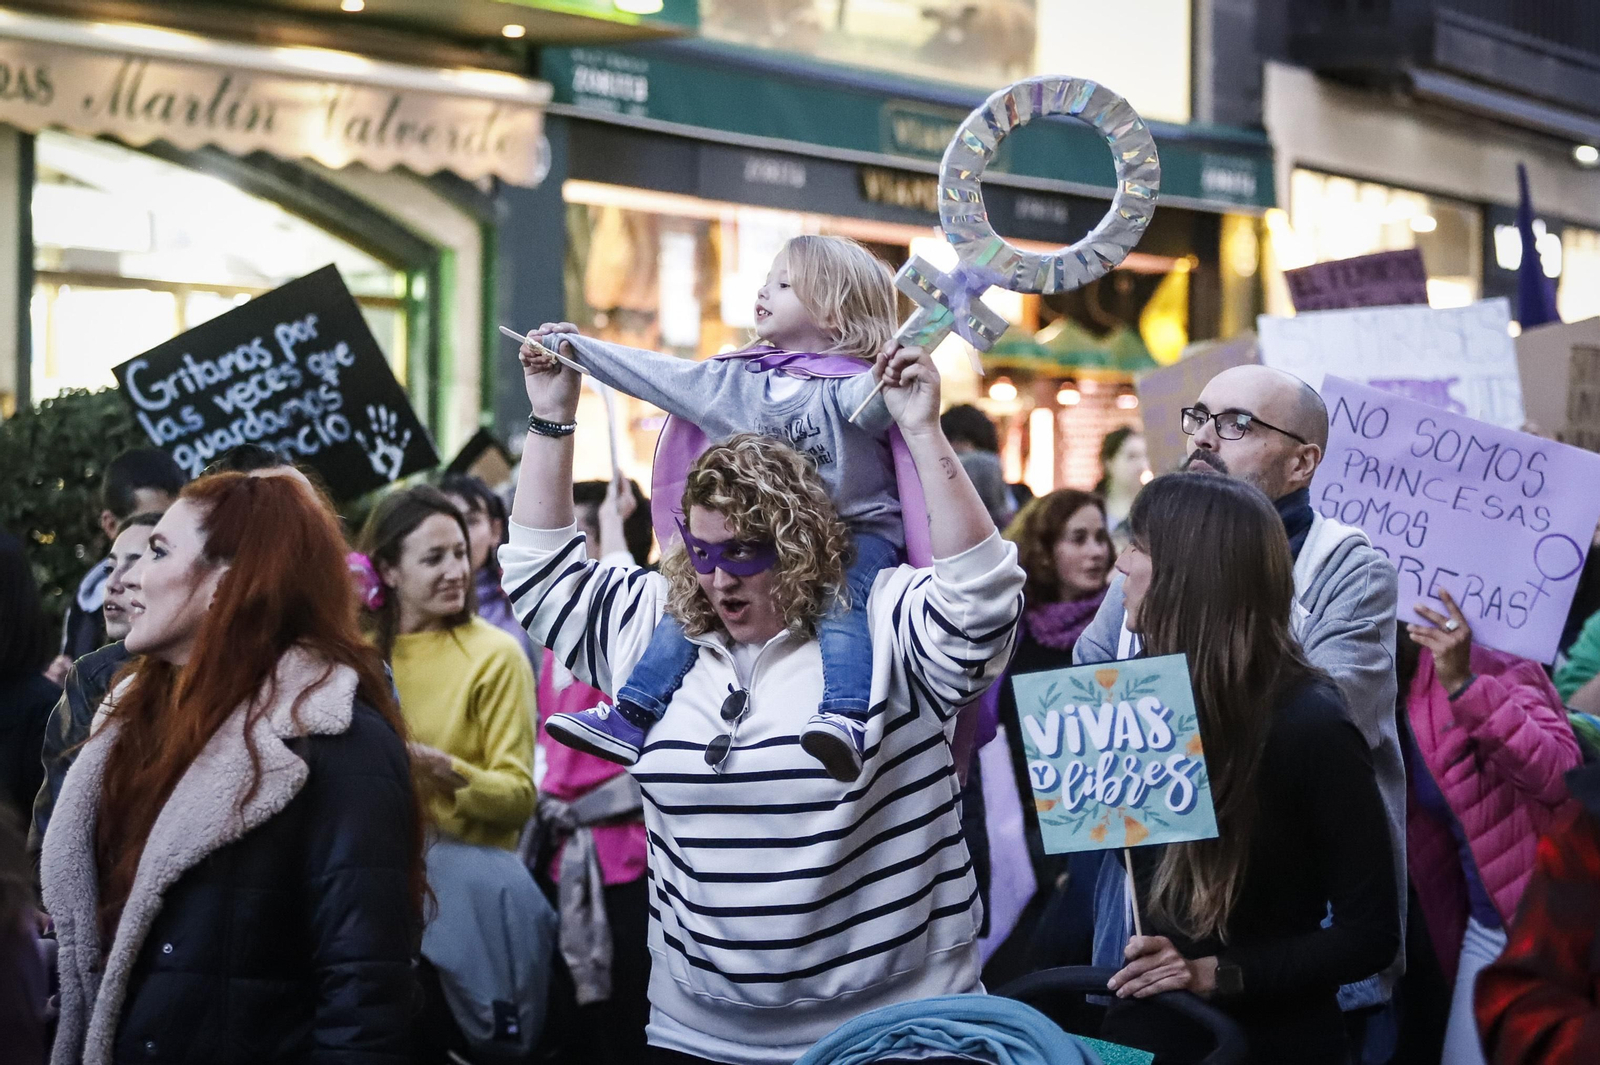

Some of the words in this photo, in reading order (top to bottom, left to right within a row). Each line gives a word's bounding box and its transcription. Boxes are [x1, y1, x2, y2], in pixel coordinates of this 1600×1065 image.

[274, 312, 319, 363] por
[136, 404, 205, 447] las
[213, 361, 302, 415] veces
[306, 341, 356, 387] que
[1329, 396, 1390, 440] NO
[1410, 417, 1549, 499] SOMOS
[1318, 482, 1429, 549] SOMOS
[1343, 448, 1551, 533] PRINCESAS
[1061, 751, 1201, 814] libres
